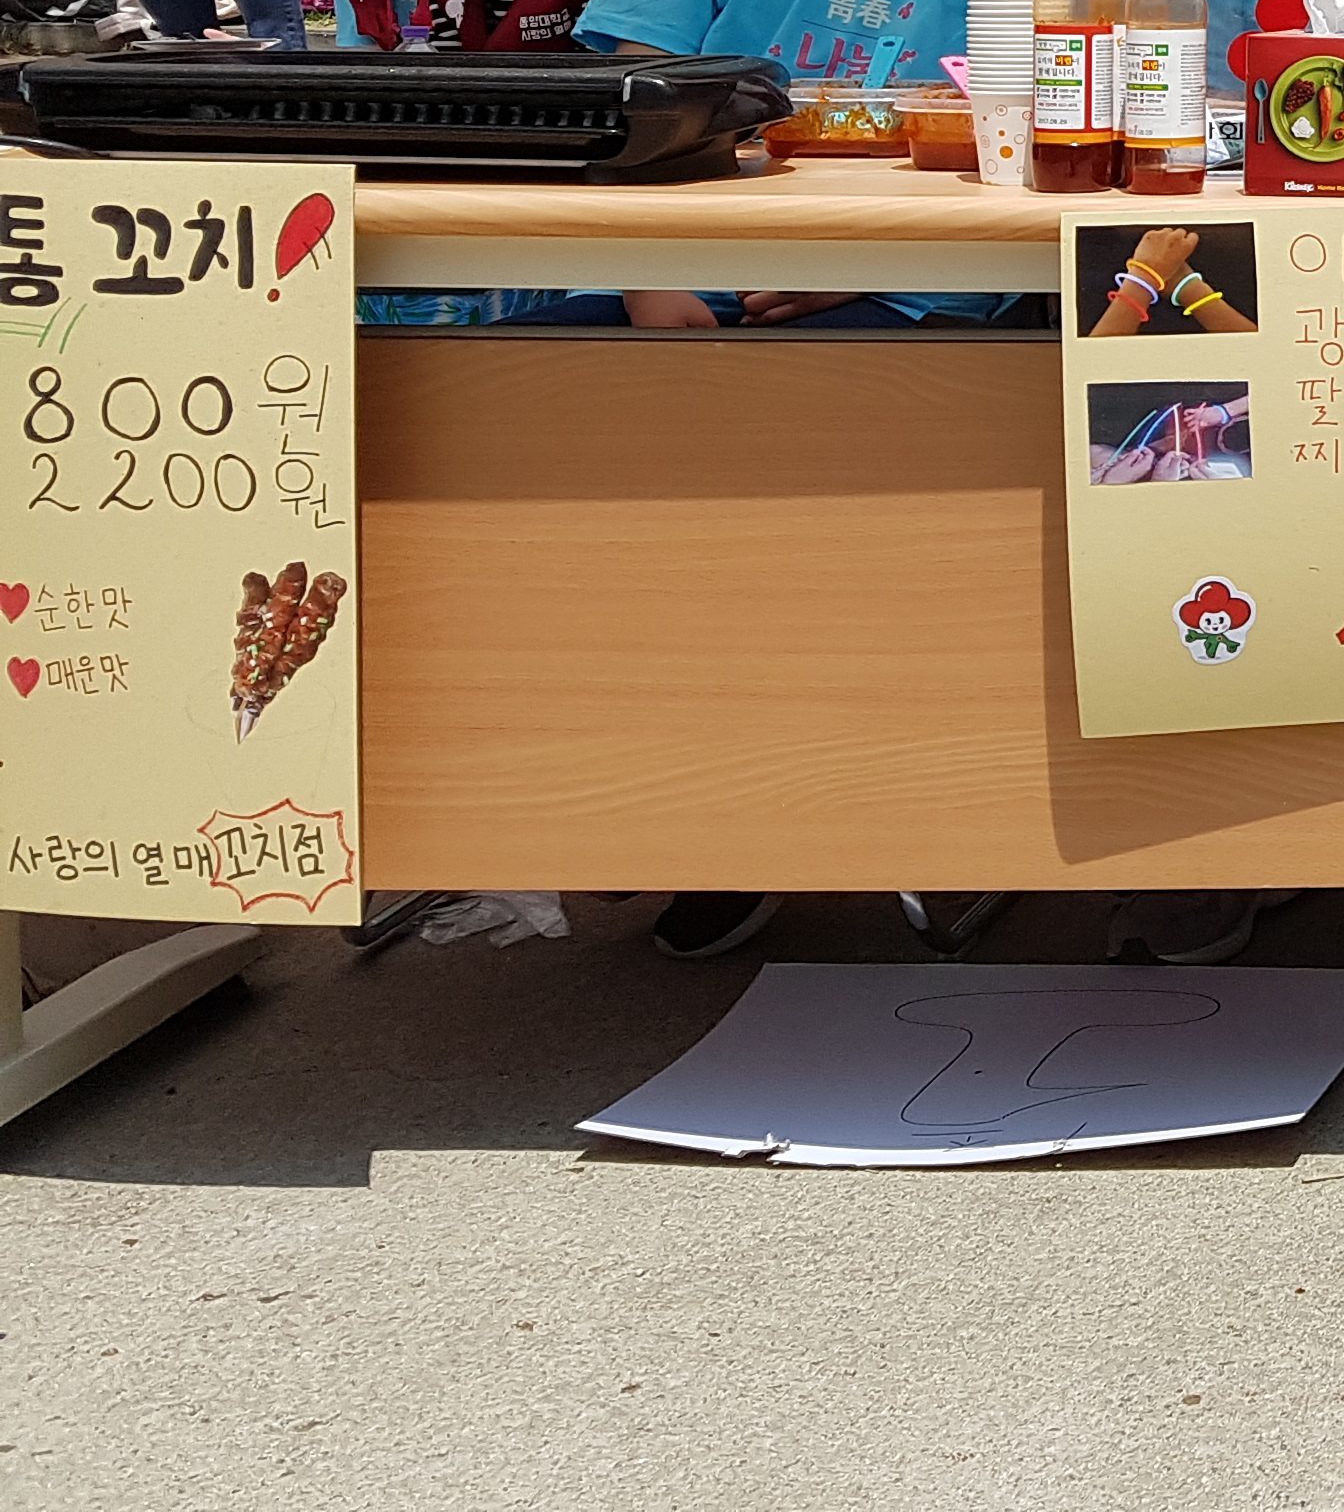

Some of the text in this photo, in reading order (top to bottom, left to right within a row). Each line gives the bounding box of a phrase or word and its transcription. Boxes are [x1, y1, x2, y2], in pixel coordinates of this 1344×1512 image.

[23, 354, 330, 457] 800원
[28, 448, 346, 530] 2200원
[9, 835, 120, 881] 사랑의
[214, 822, 326, 881] 꼬치점
